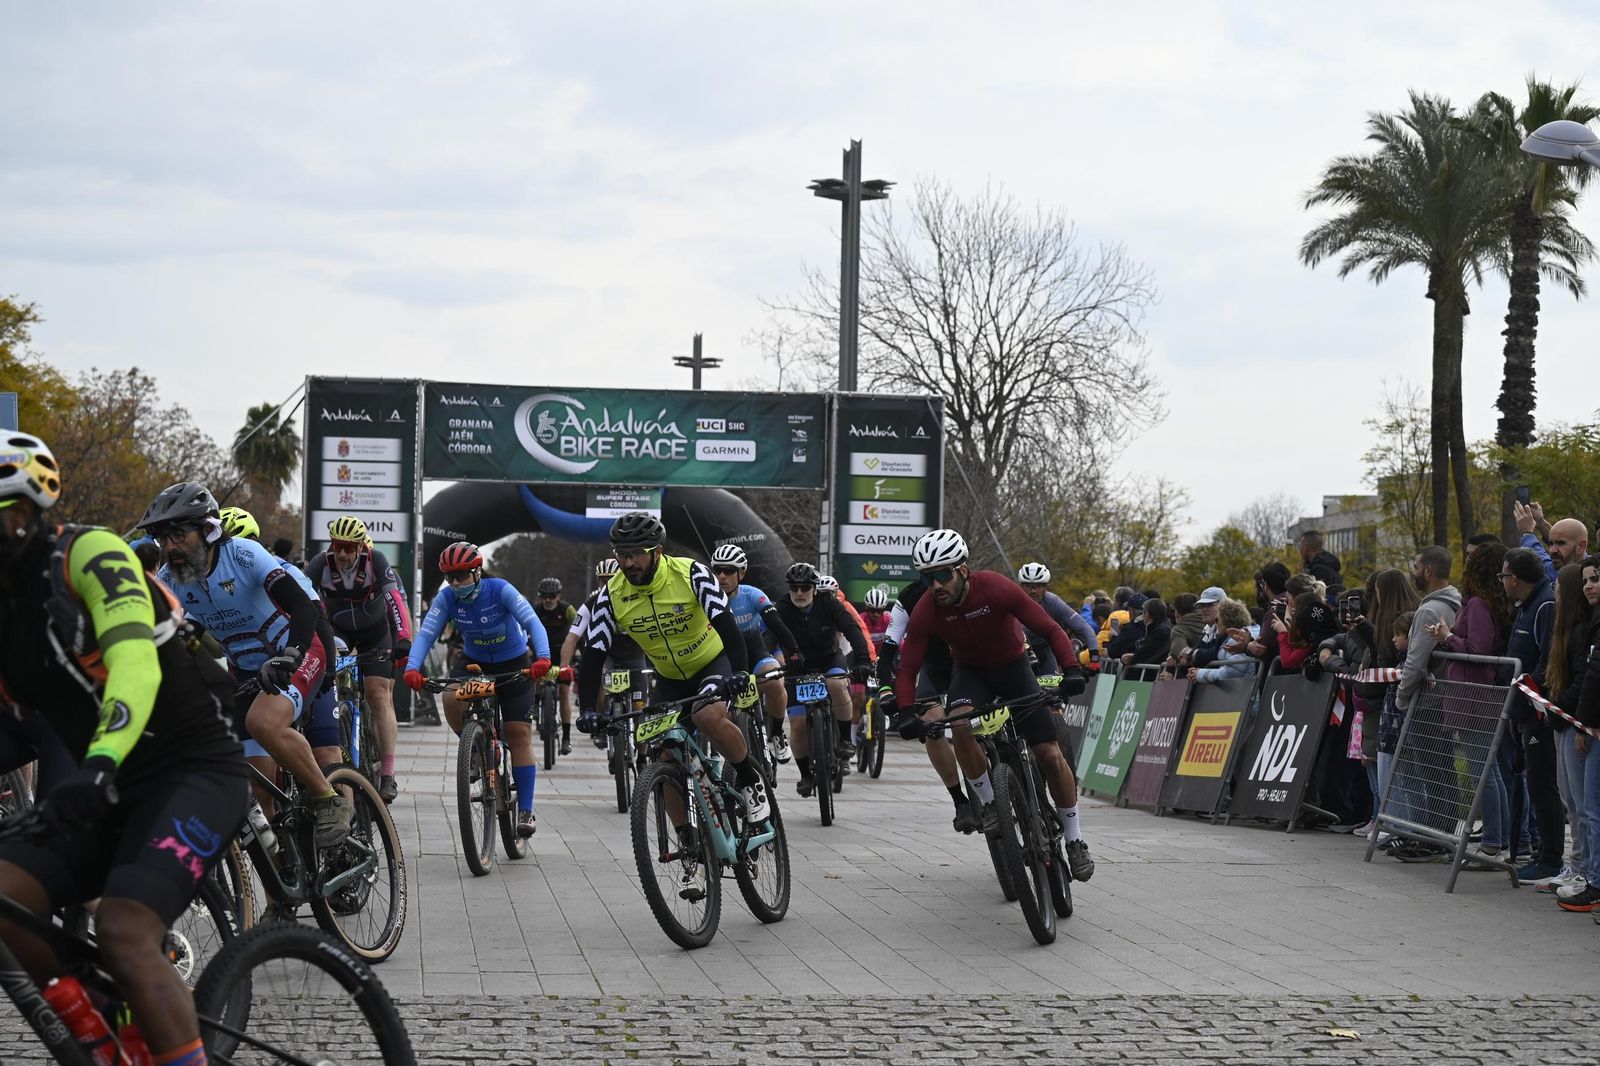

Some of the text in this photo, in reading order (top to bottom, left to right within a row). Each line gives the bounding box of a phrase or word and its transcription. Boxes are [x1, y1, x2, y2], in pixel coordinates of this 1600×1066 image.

[449, 418, 494, 431] GRANADA
[560, 405, 687, 440] Andalucía
[701, 421, 745, 431] UCI SHC
[448, 429, 473, 441] JAÉN
[447, 442, 492, 455] CÓRDOBA
[560, 436, 688, 460] BIKE RACE
[702, 446, 750, 456] GARMIN
[677, 631, 709, 658] cajasur
[613, 674, 629, 686] 614
[799, 684, 824, 698] 412-2
[1062, 703, 1089, 728] ARMIN
[1184, 726, 1233, 764] PIRELLI
[1248, 724, 1308, 783] NDL
[317, 941, 370, 980] PIRELLI
